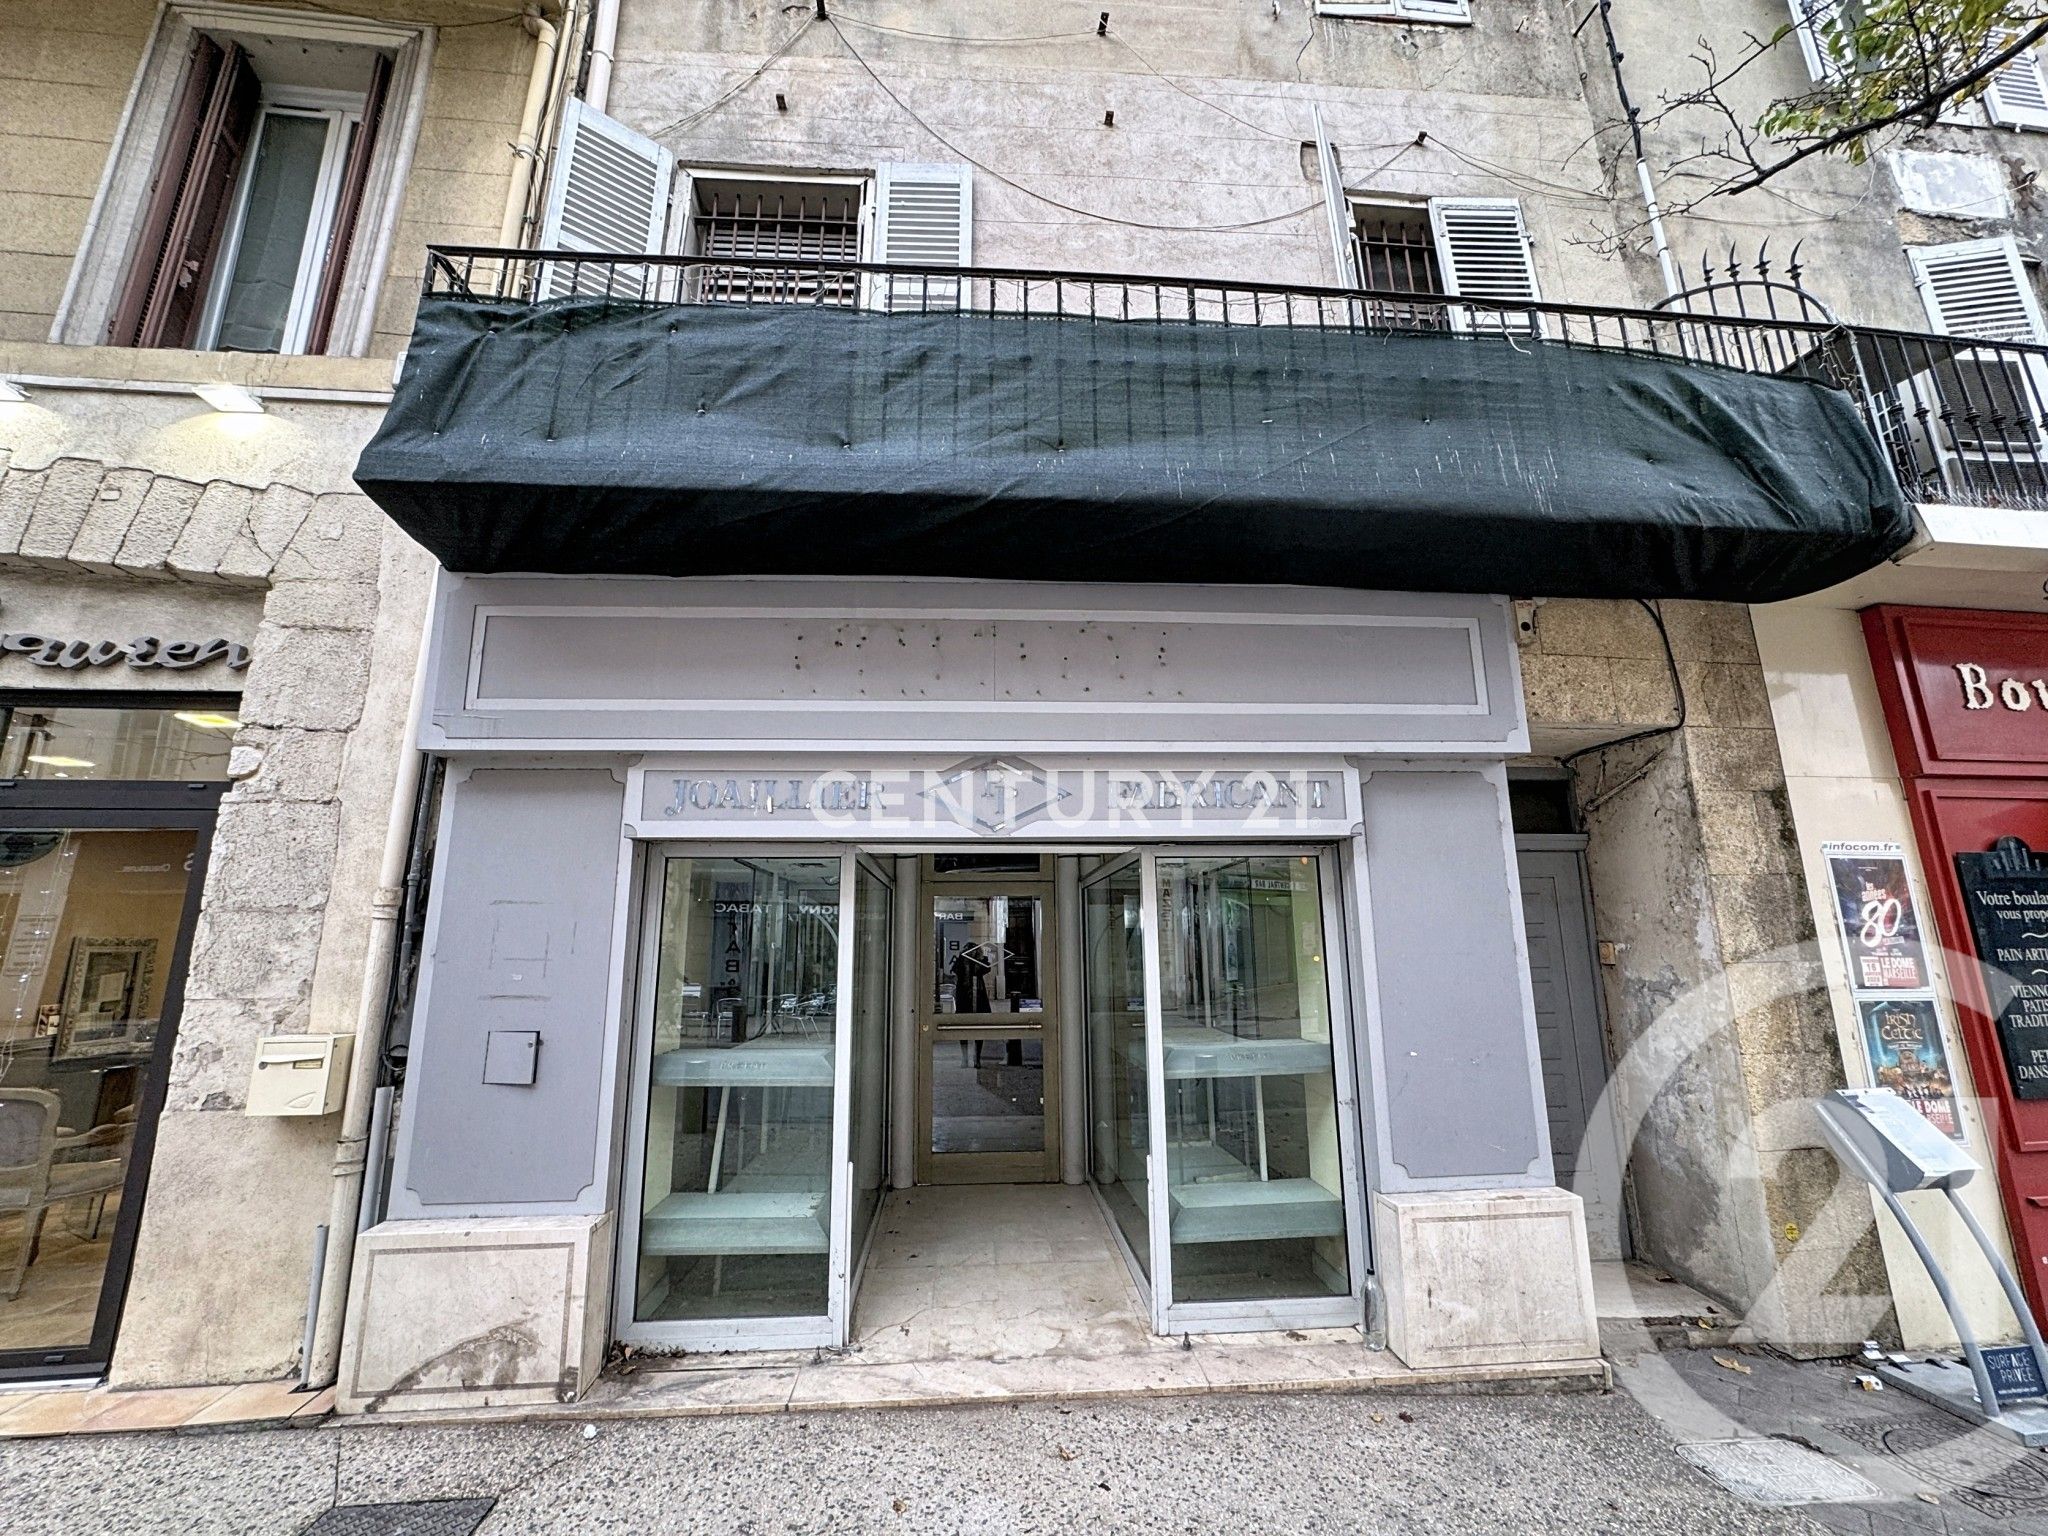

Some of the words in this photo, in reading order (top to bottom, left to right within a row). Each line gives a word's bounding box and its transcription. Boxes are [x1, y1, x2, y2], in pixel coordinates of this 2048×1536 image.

[1828, 841, 1895, 853] infocom.fr
[1976, 890, 2012, 906] Votre
[1996, 909, 2022, 920] vous
[1860, 897, 1902, 948] 80
[1997, 948, 2023, 962] PAIN
[1880, 957, 1890, 968] LE
[1924, 1100, 1951, 1114] DOME
